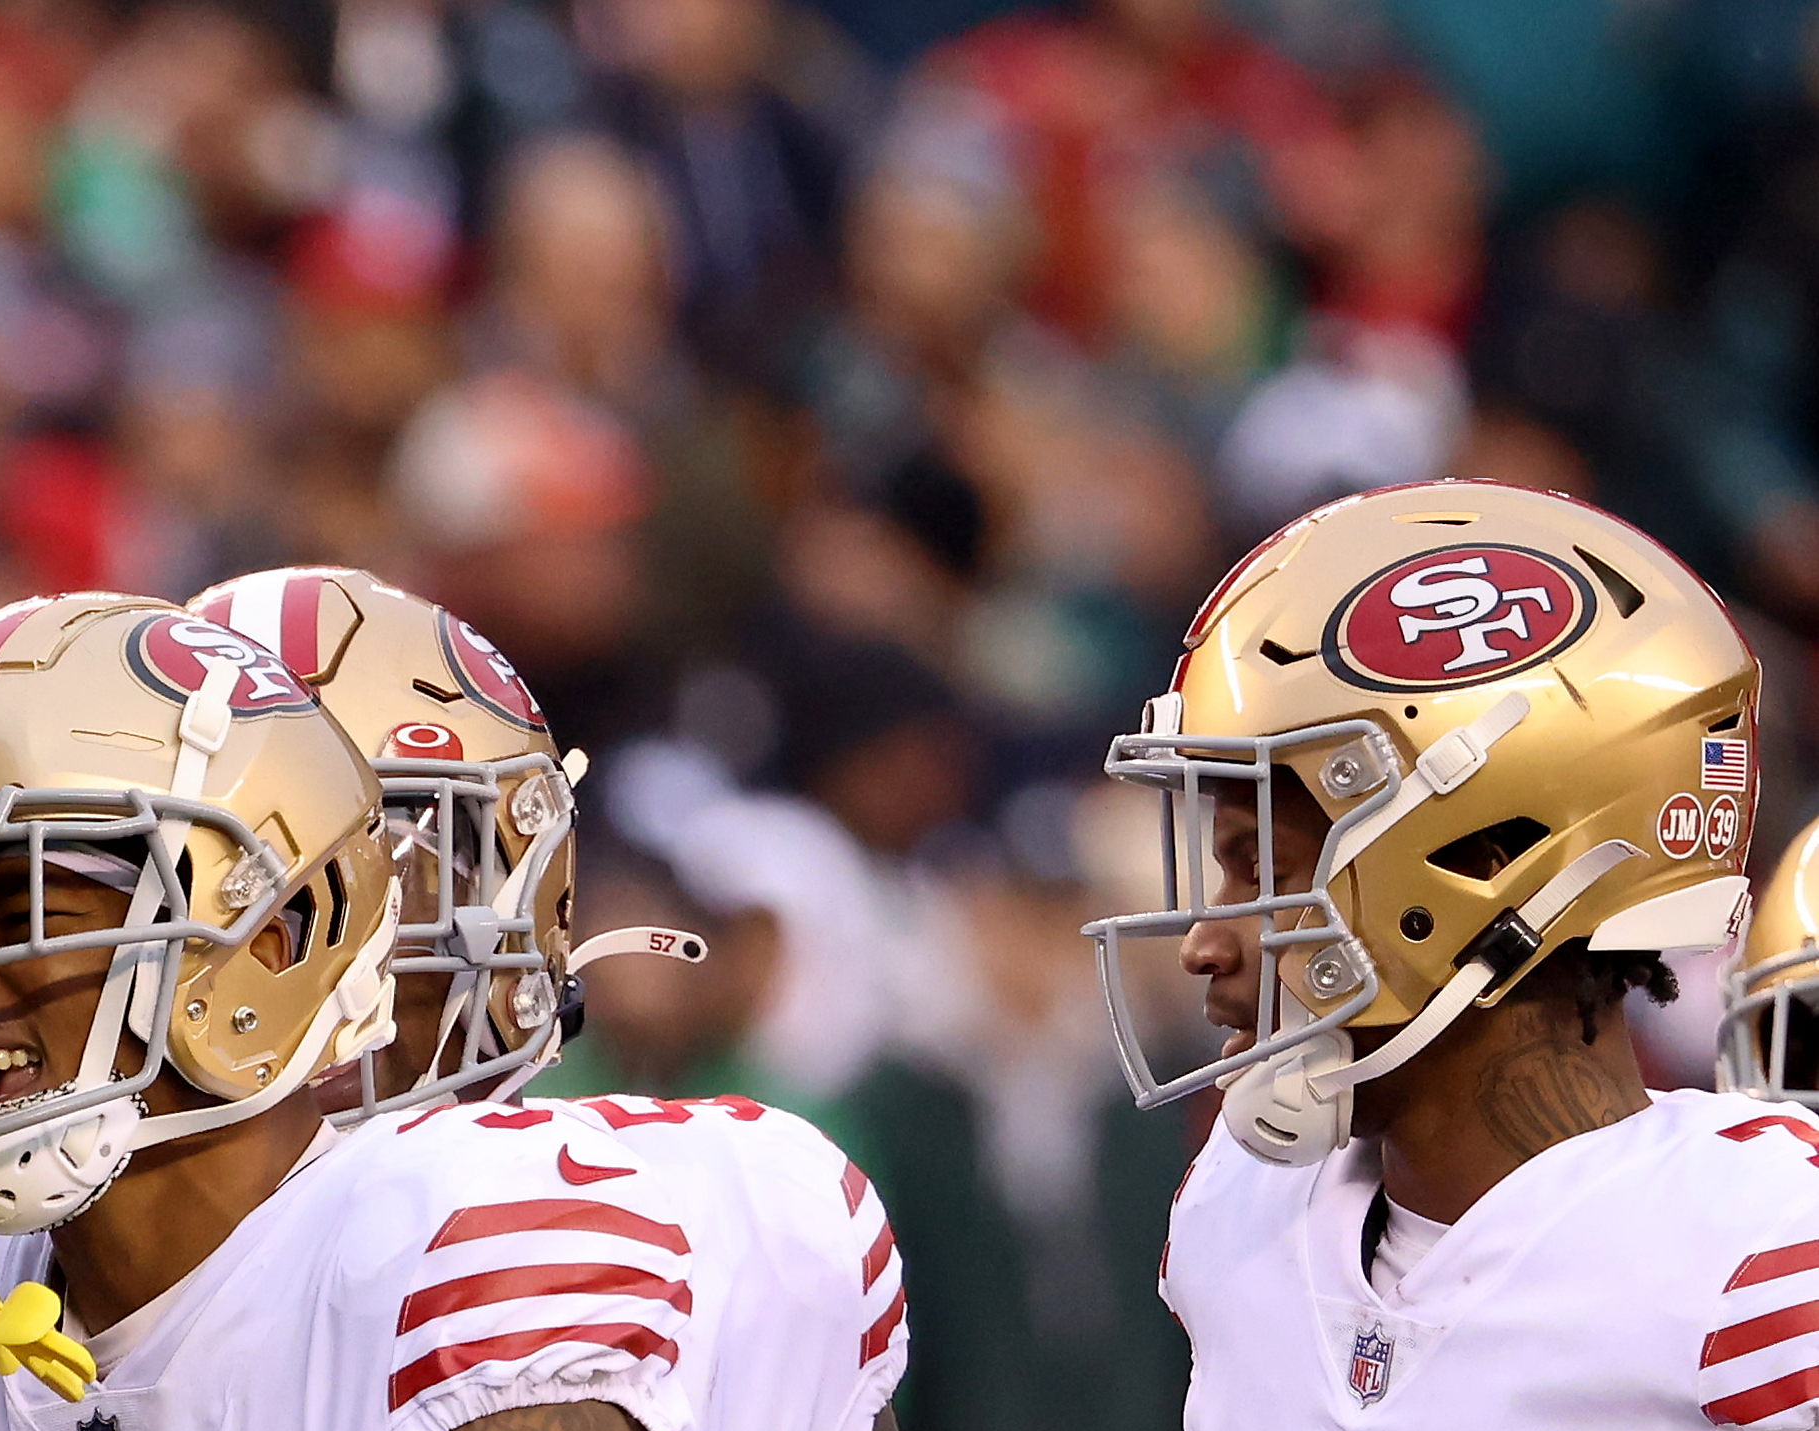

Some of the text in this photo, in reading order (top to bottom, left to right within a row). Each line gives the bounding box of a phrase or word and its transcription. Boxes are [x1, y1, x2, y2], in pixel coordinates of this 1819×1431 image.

[1390, 556, 1552, 672] SF
[1662, 808, 1736, 847] JM 39
[649, 933, 677, 953] 57
[1351, 1358, 1380, 1393] NFL
